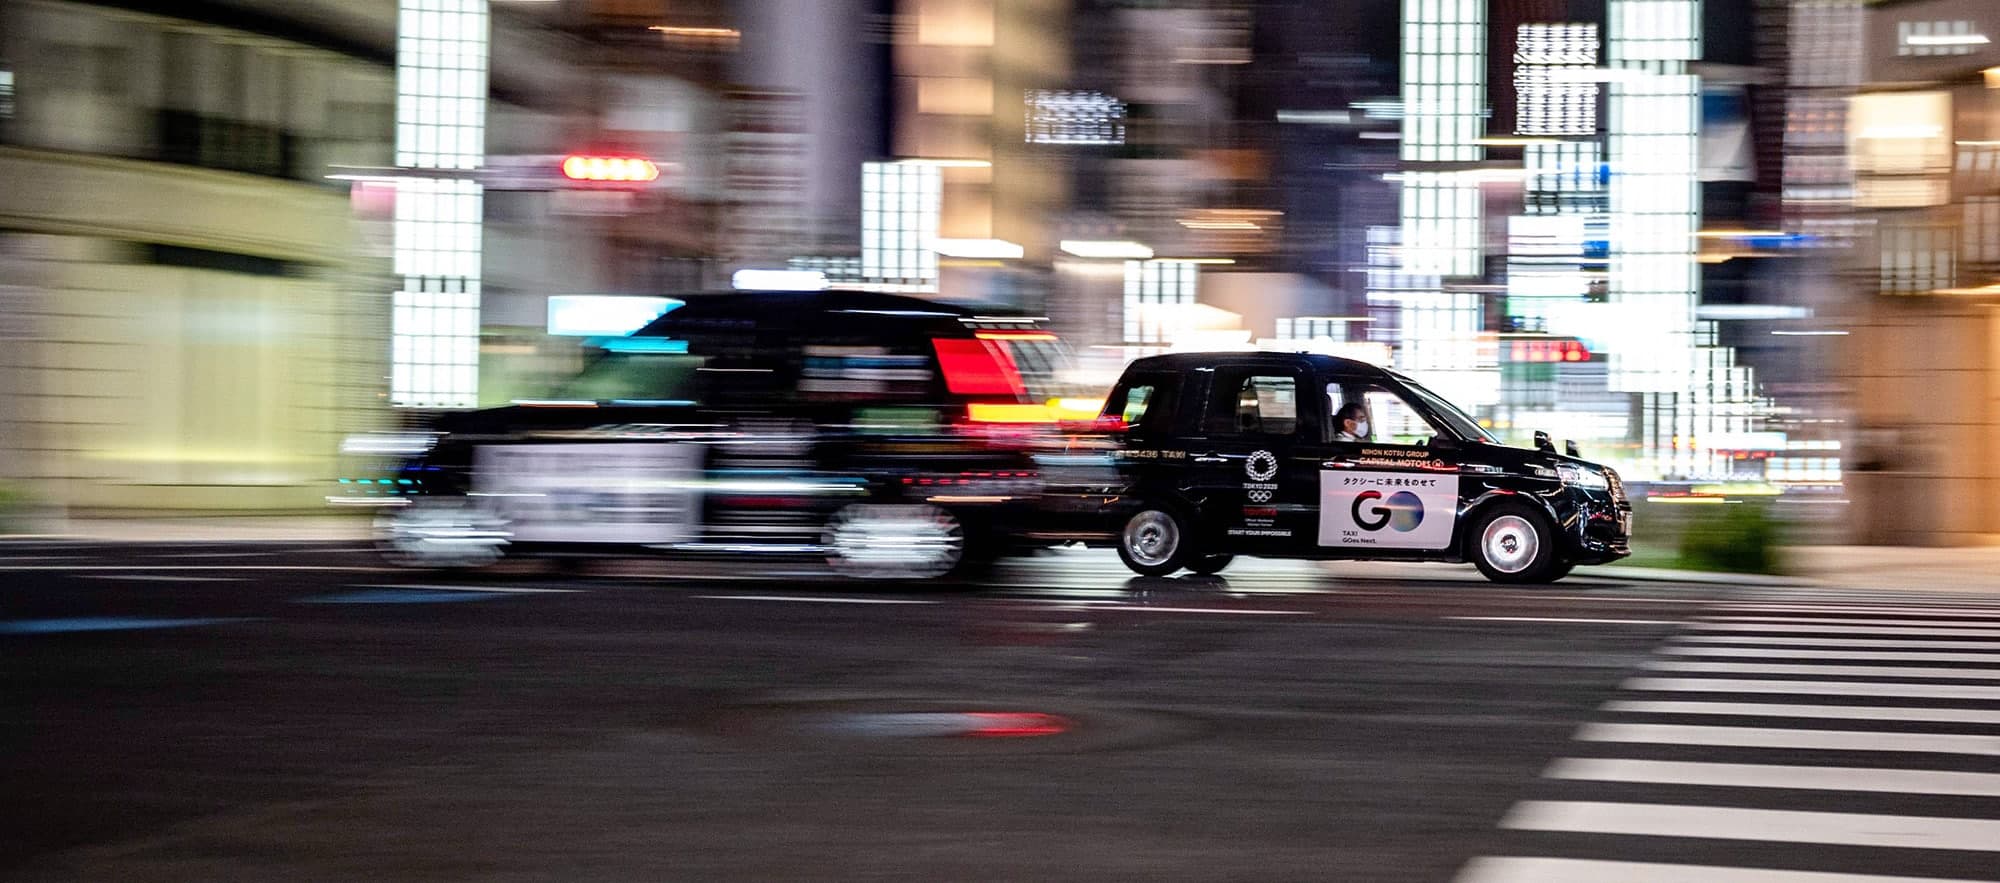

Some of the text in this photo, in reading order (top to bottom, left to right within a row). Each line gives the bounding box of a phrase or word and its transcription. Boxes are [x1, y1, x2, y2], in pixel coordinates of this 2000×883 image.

[1161, 450, 1186, 458] TAXI
[1361, 448, 1429, 458] NIHON KOTSU GROUP
[1344, 477, 1436, 487] タクシーに未来をのせて
[1351, 490, 1424, 532] GO
